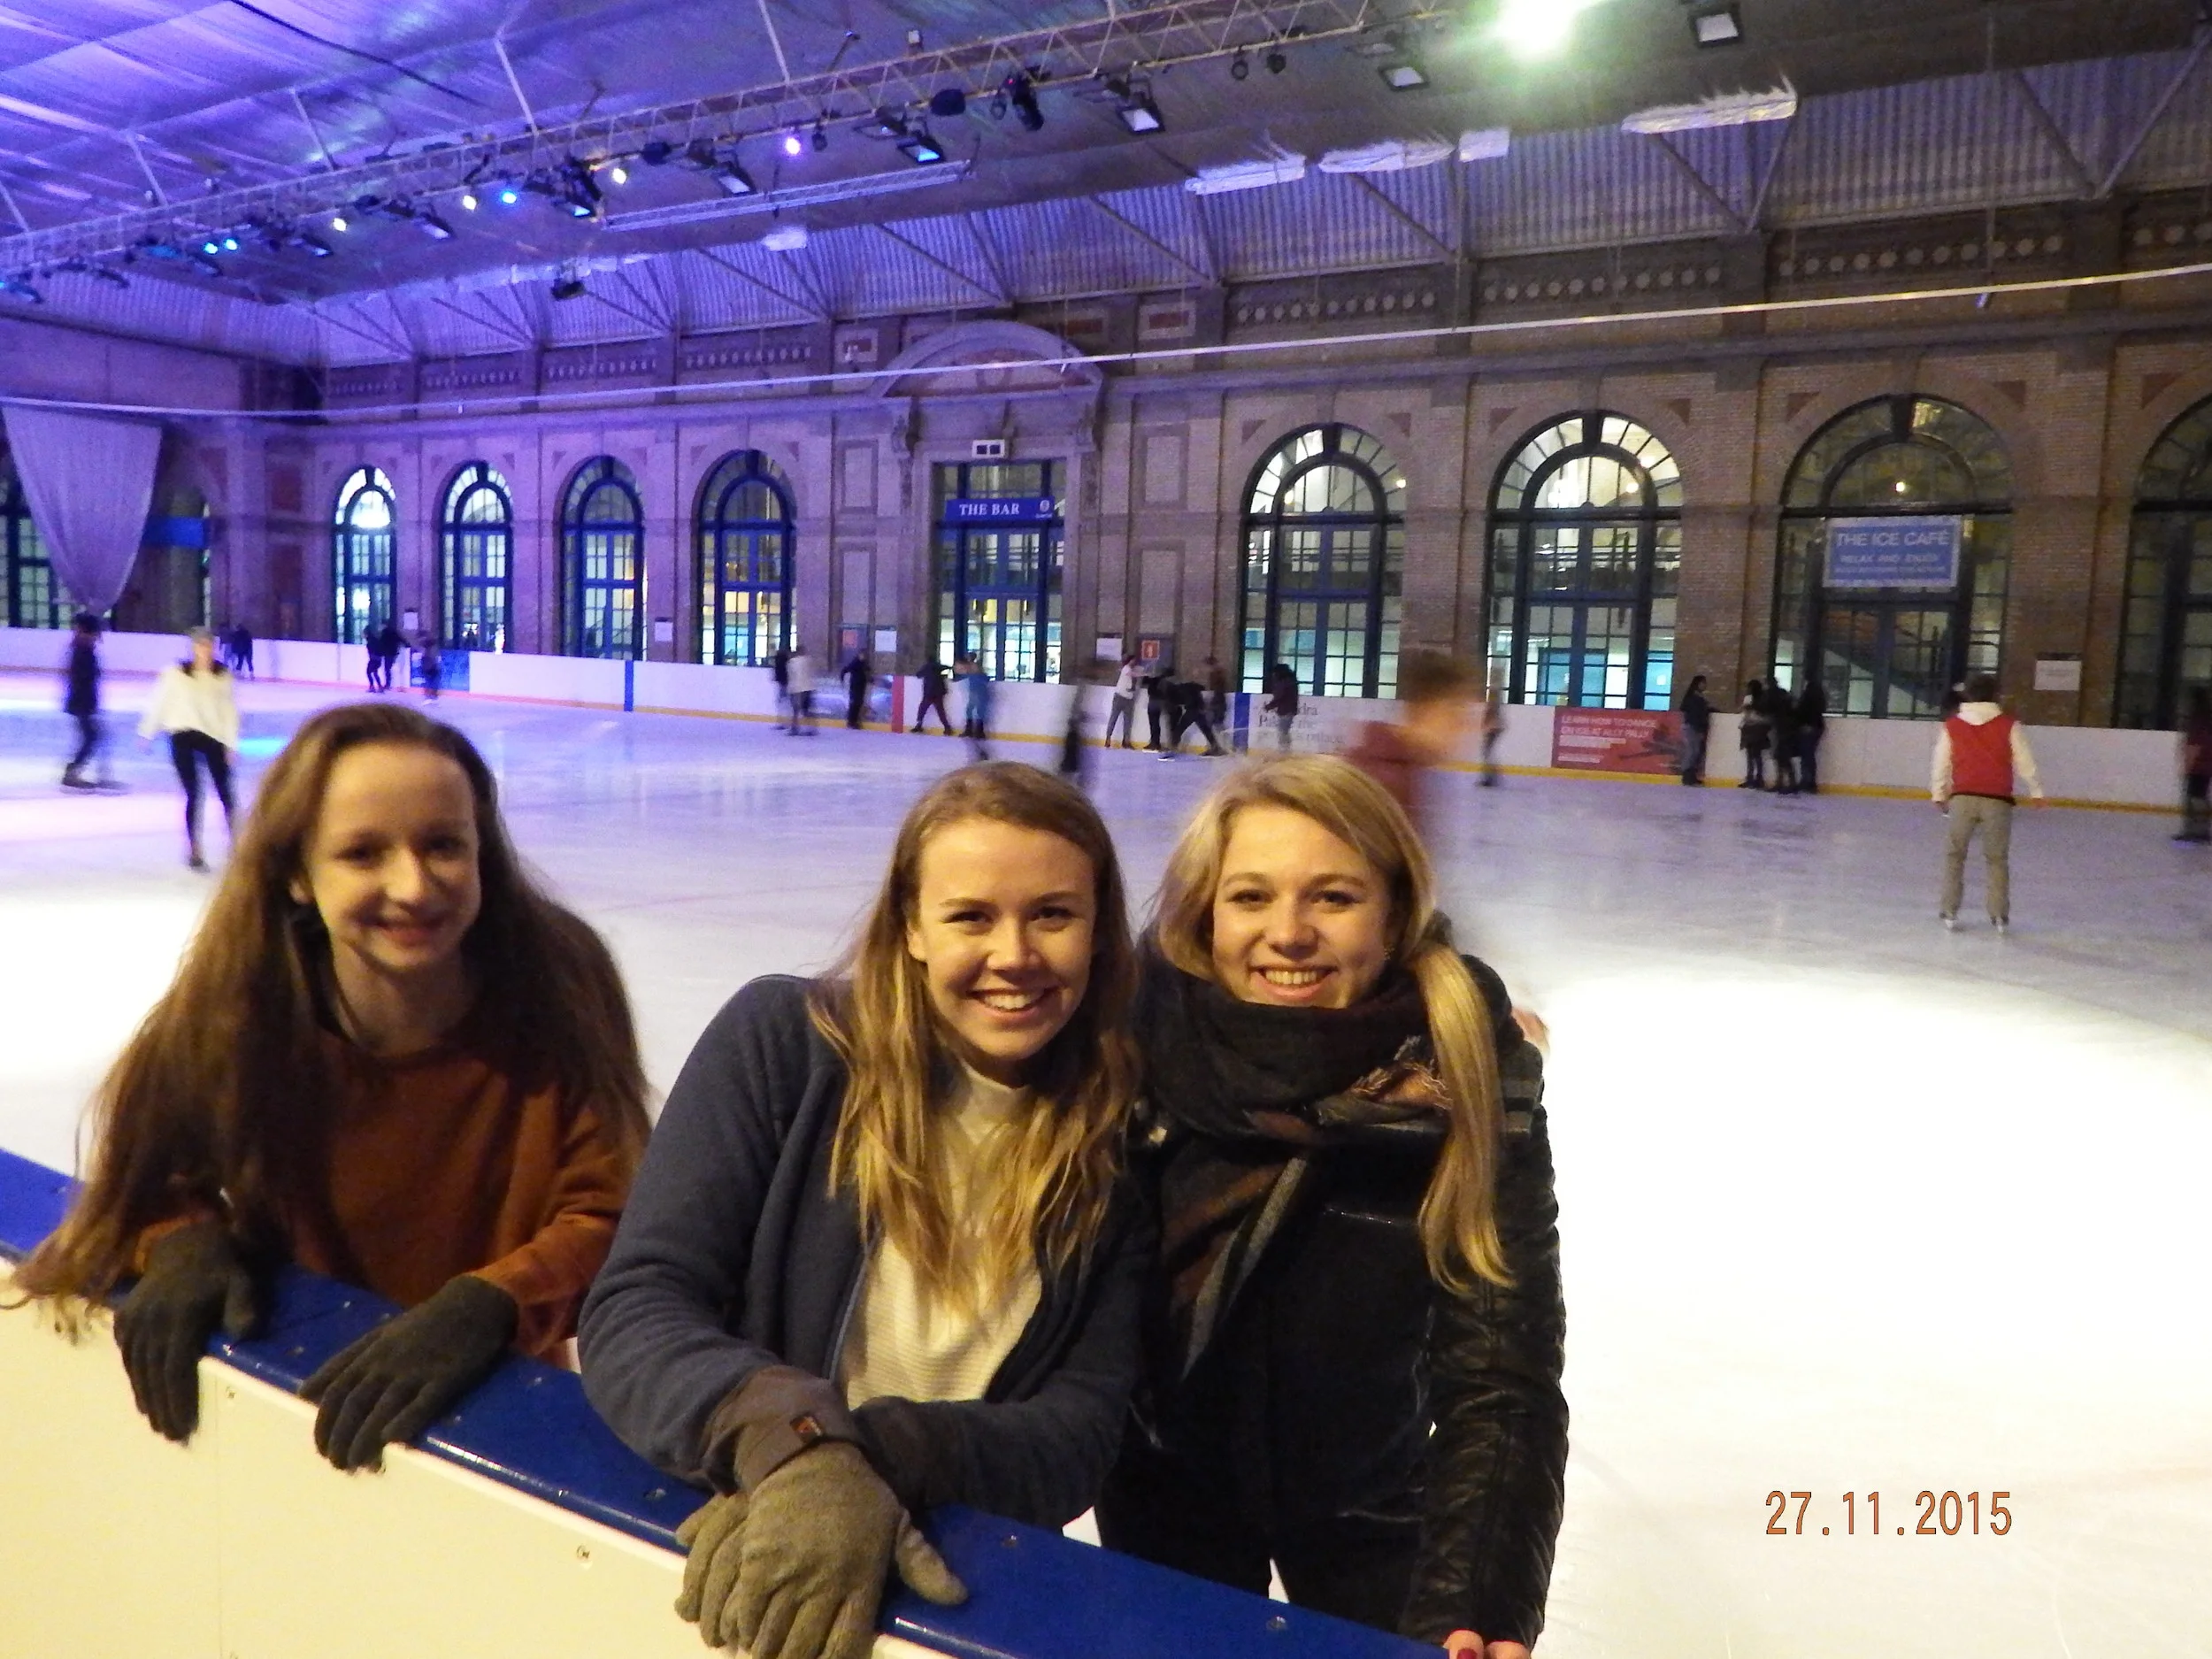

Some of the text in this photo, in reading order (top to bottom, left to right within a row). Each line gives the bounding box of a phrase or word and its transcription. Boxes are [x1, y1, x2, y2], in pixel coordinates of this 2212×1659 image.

[959, 503, 1019, 516] THE BAR
[1837, 533, 1868, 546] THE
[1871, 532, 1900, 546] ICE
